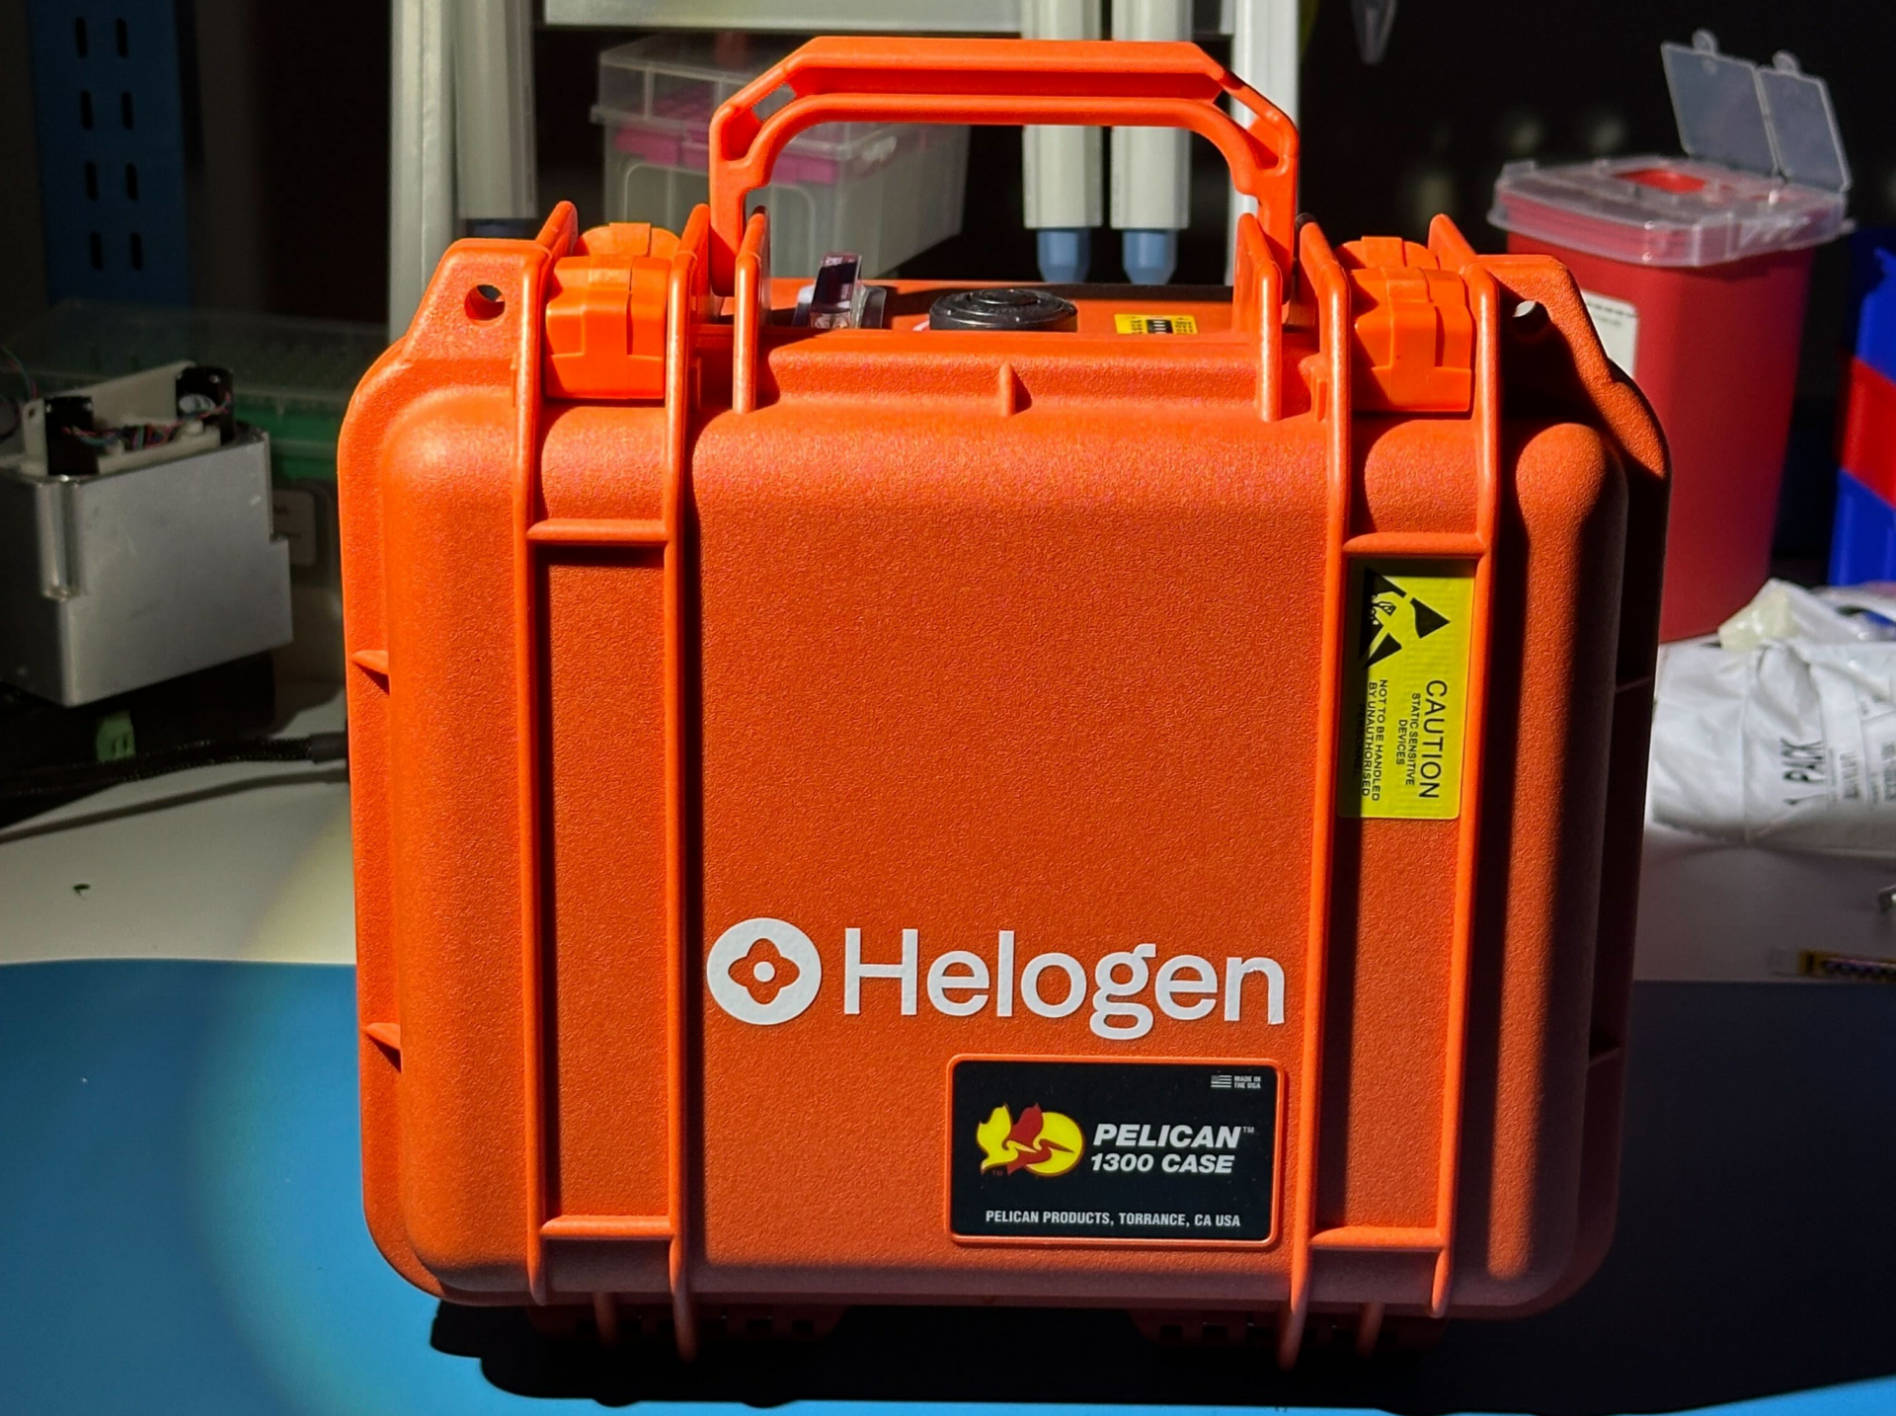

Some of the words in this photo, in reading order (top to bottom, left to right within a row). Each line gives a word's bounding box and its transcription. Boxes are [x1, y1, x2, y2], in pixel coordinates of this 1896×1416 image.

[1368, 682, 1378, 698] BY
[1378, 679, 1388, 705] NOT
[1376, 708, 1386, 723] TO
[1411, 693, 1421, 729] STATIC
[1361, 701, 1376, 796] UNAUTHORISED
[1375, 726, 1385, 741] BE
[1397, 719, 1408, 765] DEVICES
[1418, 680, 1447, 798] CAUTION
[1371, 745, 1383, 801] HANDLED
[1405, 731, 1418, 786] SENSITIVE
[843, 927, 1285, 1040] Helogen
[1091, 1153, 1154, 1172] 1300
[1161, 1154, 1235, 1174] CASE
[985, 1210, 1039, 1224] PELICAN
[1043, 1211, 1114, 1226] PRODUCTS,
[1119, 1212, 1190, 1228] TORRANCE,
[1194, 1213, 1211, 1227] CA
[1215, 1214, 1241, 1227] USA
